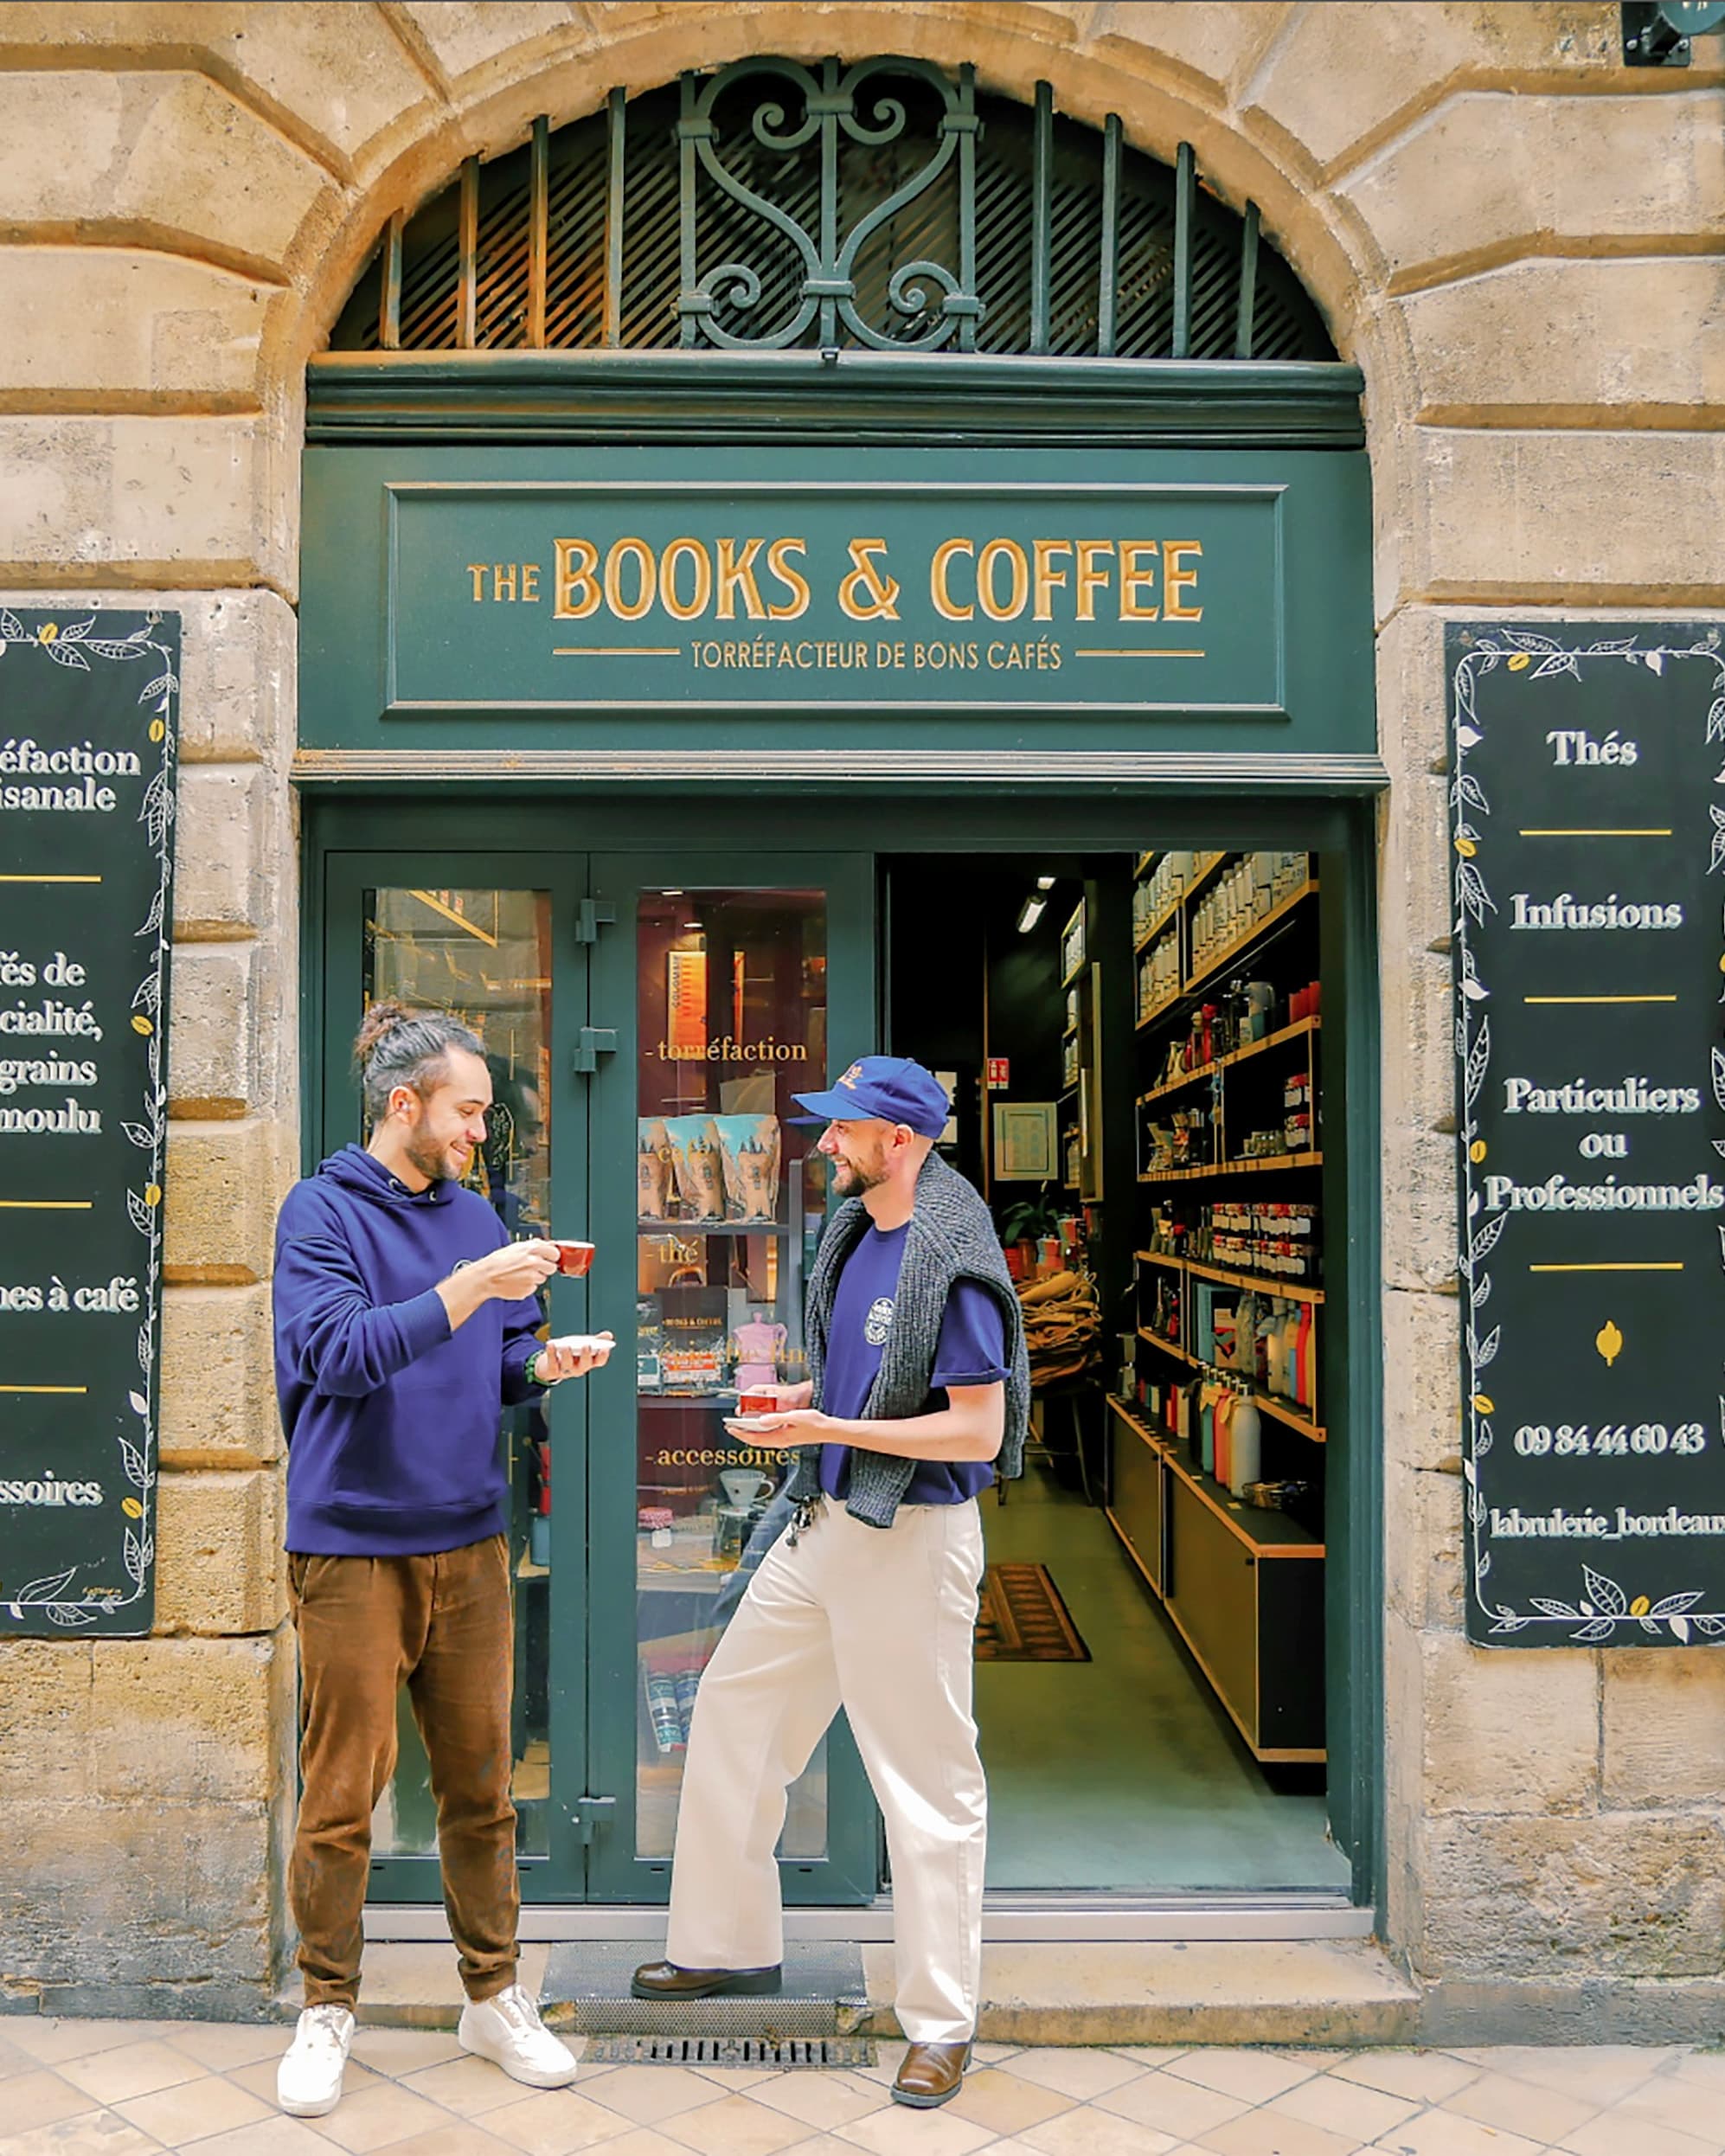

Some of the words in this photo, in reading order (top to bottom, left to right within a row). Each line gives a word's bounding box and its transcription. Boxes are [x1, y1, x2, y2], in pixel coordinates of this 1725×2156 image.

[465, 562, 541, 603] THE
[552, 537, 811, 621] BOOKS
[837, 537, 901, 621] &
[930, 537, 1204, 623] COFFEE
[690, 633, 869, 669] TORRÉFACTEUR
[876, 641, 906, 669] DE
[914, 641, 979, 670] BONS
[986, 634, 1062, 670] CAFÉS
[1545, 729, 1638, 767] Thés
[1509, 893, 1683, 930] Infusions
[42, 951, 87, 987] de
[657, 1036, 808, 1062] torréfaction
[1503, 1077, 1701, 1113] Particuliers
[1579, 1133, 1629, 1158] ou
[1483, 1173, 1725, 1211] Professionnels
[47, 1275, 71, 1312] à
[73, 1276, 139, 1313] café
[657, 1447, 801, 1466] accessoires
[1514, 1425, 1552, 1456] 09
[1554, 1424, 1591, 1456] 84
[1592, 1424, 1629, 1455] 44
[1630, 1423, 1669, 1454] 60
[1669, 1422, 1706, 1454] 43
